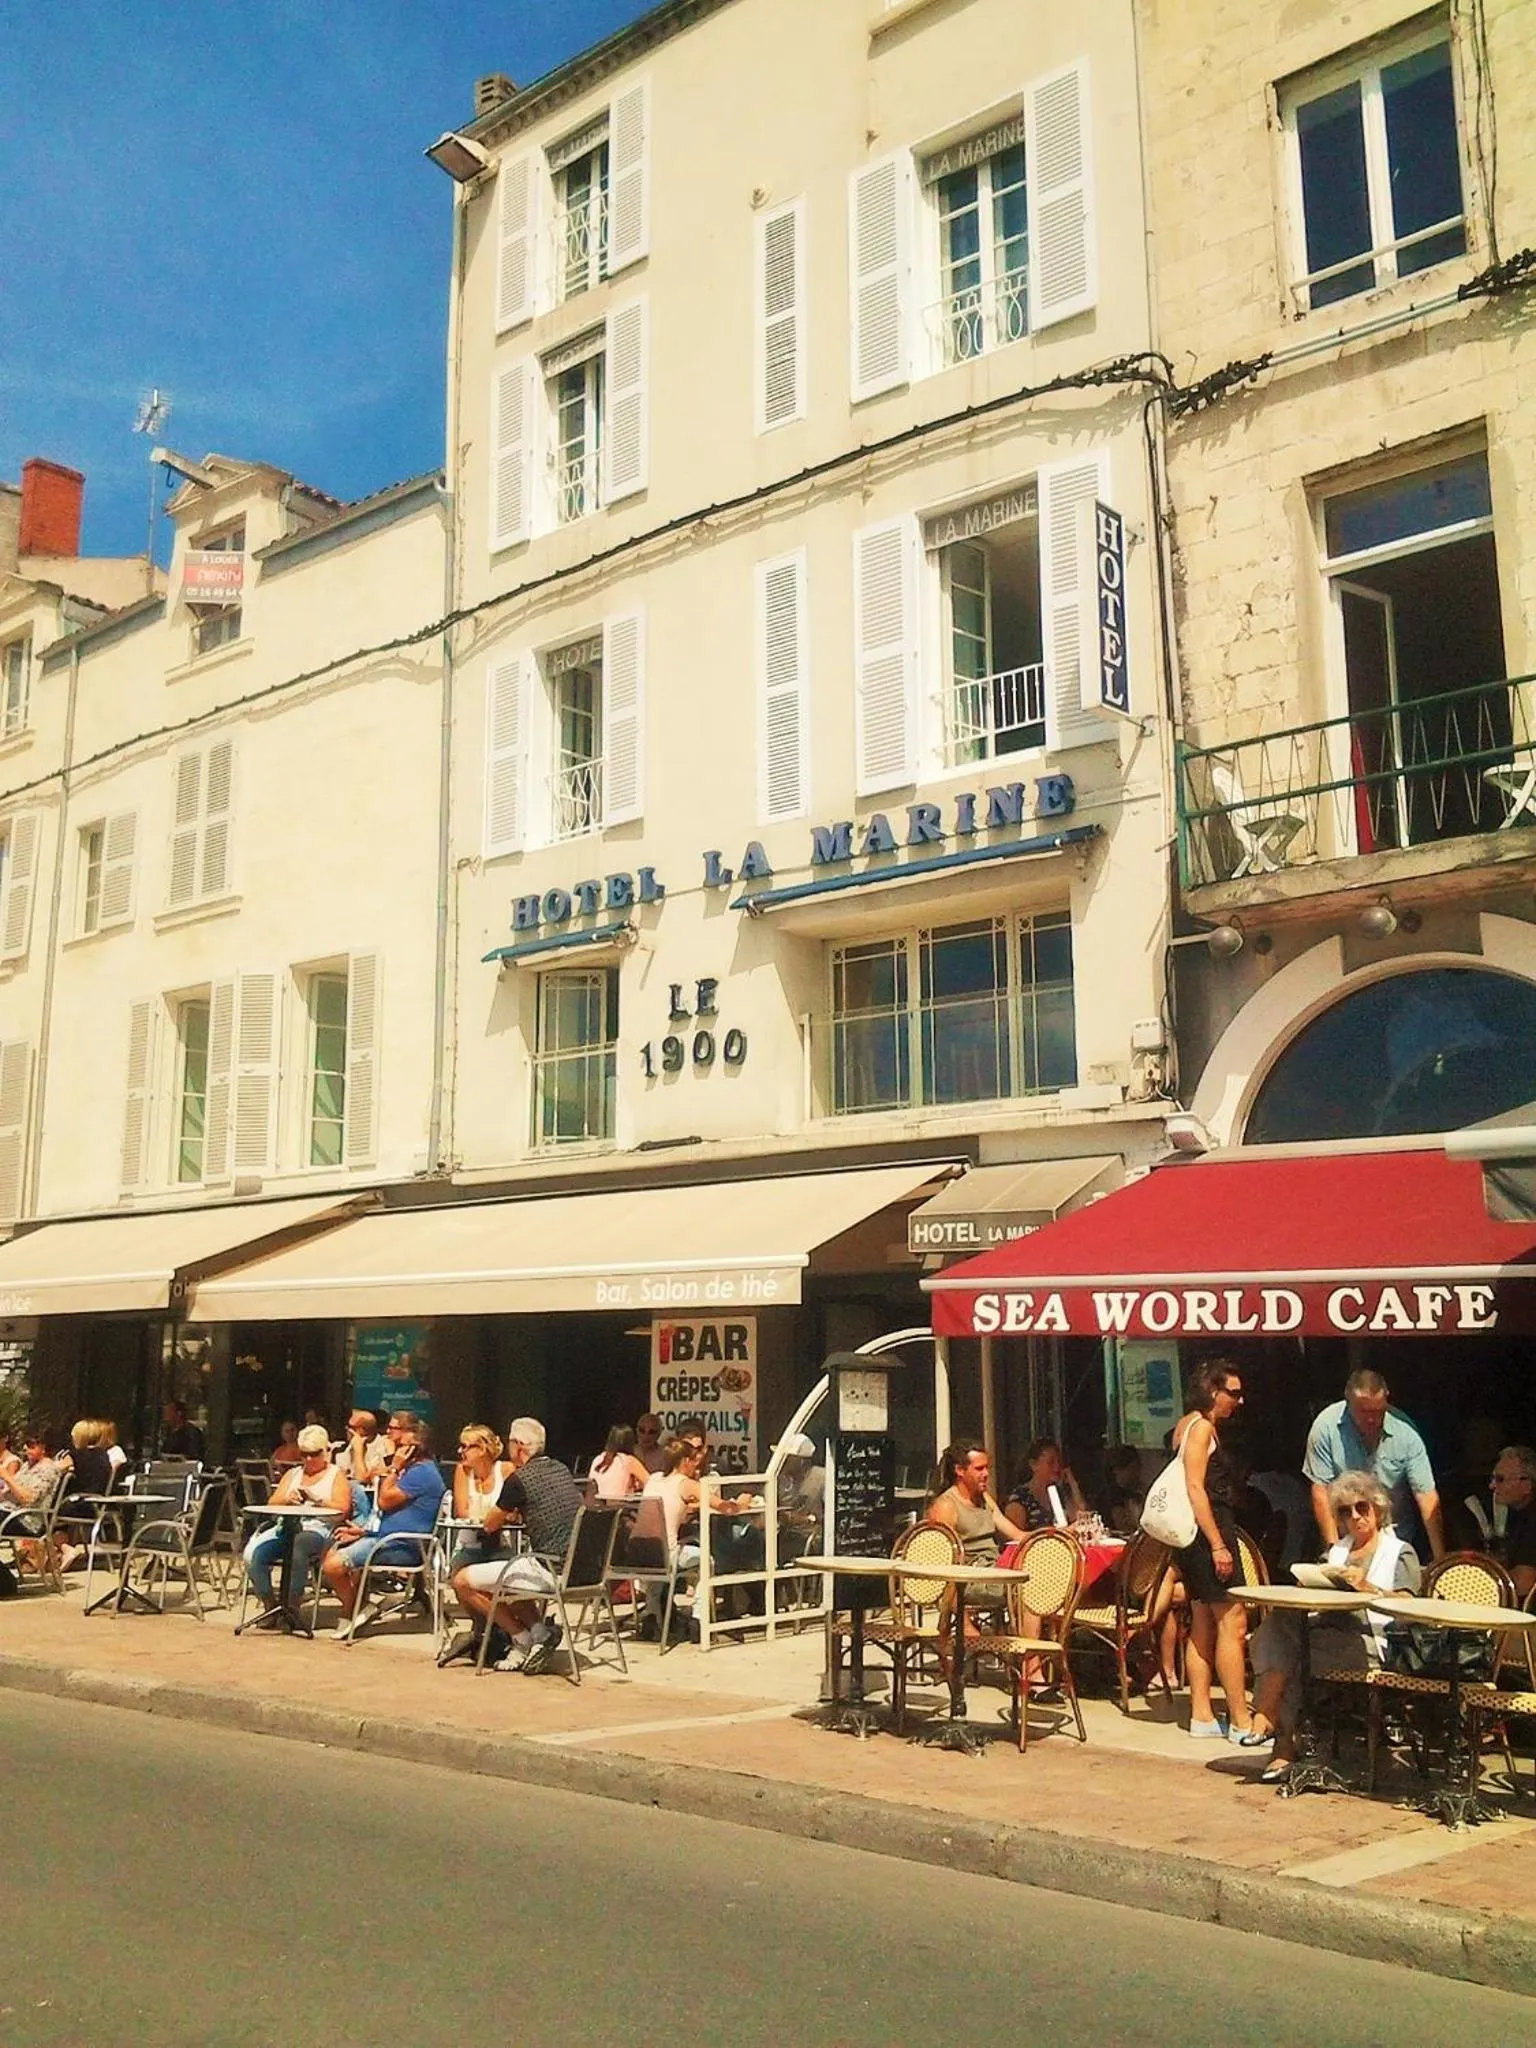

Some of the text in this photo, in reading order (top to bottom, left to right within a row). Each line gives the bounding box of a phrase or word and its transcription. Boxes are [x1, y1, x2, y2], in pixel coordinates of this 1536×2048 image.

[930, 153, 952, 181] LA
[934, 487, 1039, 545] LA MARINE
[1098, 509, 1125, 706] HOTEL
[511, 773, 1077, 931] HOTEL LA MARINE
[668, 978, 719, 1021] LE
[640, 1028, 748, 1078] 1900
[913, 1222, 981, 1244] HOTEL
[988, 1226, 1004, 1241] LA
[595, 1270, 778, 1305] Bar, Salon de thé
[972, 1284, 1499, 1334] SEA WORLD CAFE
[671, 1324, 749, 1362] BAR
[656, 1368, 721, 1403] CRÊPES
